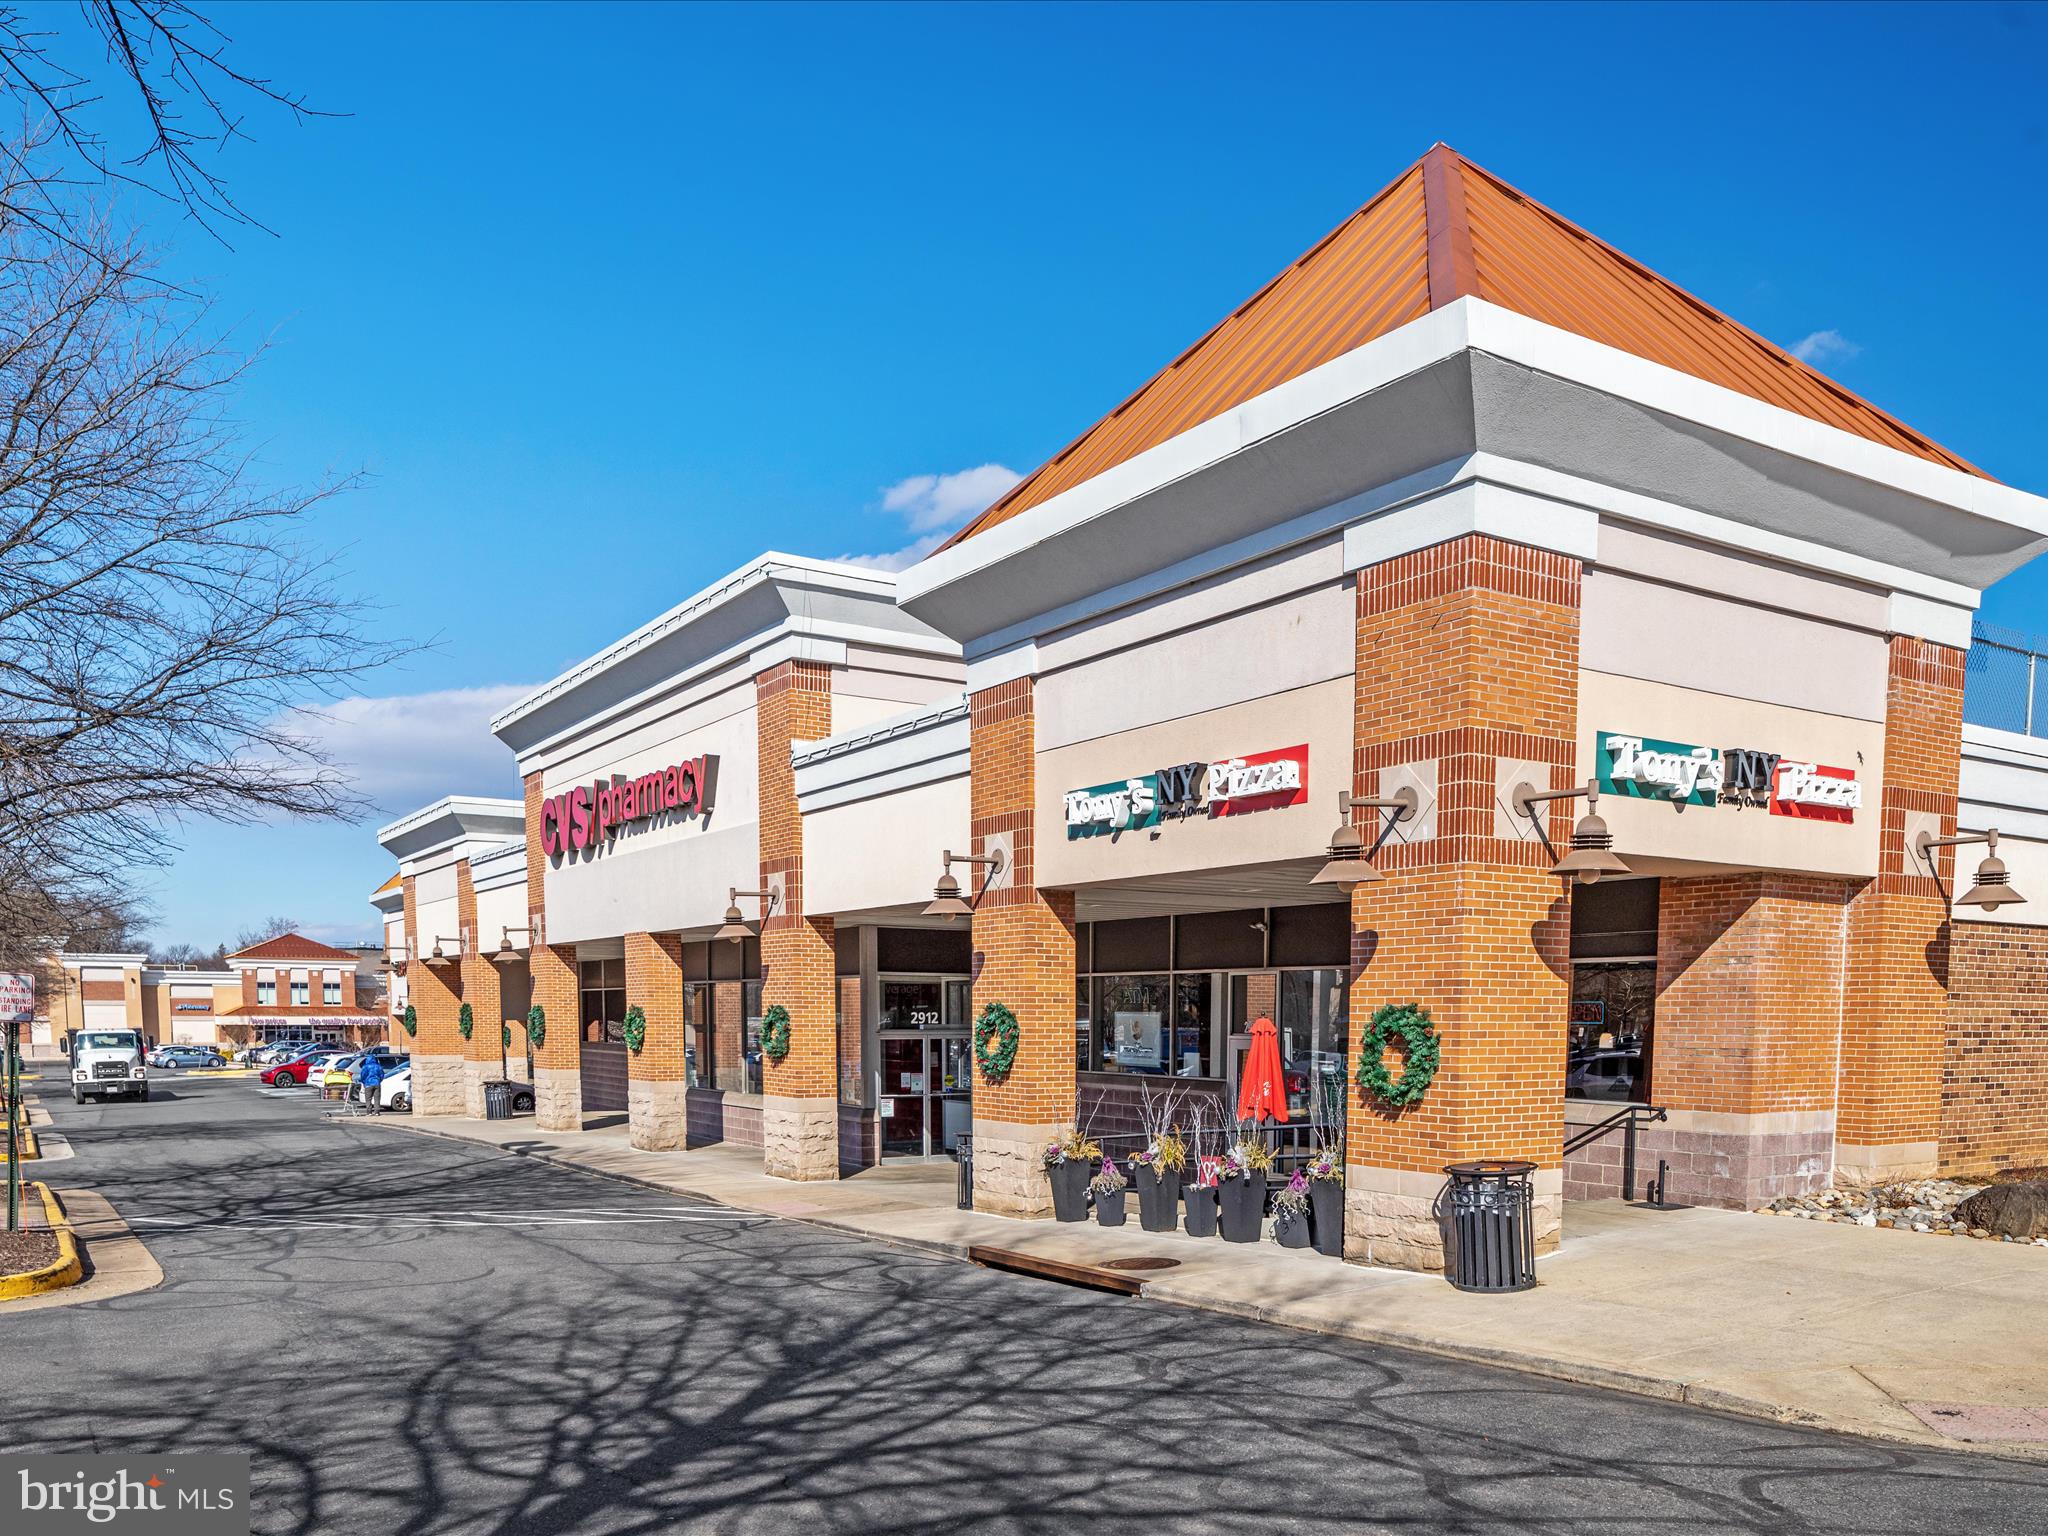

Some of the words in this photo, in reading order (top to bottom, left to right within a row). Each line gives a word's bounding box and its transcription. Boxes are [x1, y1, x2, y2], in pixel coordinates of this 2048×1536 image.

[1606, 736, 1722, 797] Tony's
[1725, 748, 1780, 791] NY
[1778, 762, 1862, 808] Pizza
[1063, 779, 1154, 827] Tony's
[1156, 763, 1204, 805] NY
[1208, 760, 1301, 801] Pizza
[1718, 793, 1743, 811] Family
[1744, 797, 1769, 810] Owned
[1162, 808, 1186, 823] Family
[1187, 806, 1209, 819] Owned
[0, 986, 31, 994] PARKING
[0, 997, 31, 1005] STANDING
[0, 1005, 11, 1013] IRE
[15, 1006, 31, 1014] LANE
[1575, 1004, 1602, 1020] PEN
[308, 1017, 321, 1025] the
[910, 1012, 939, 1024] 2912
